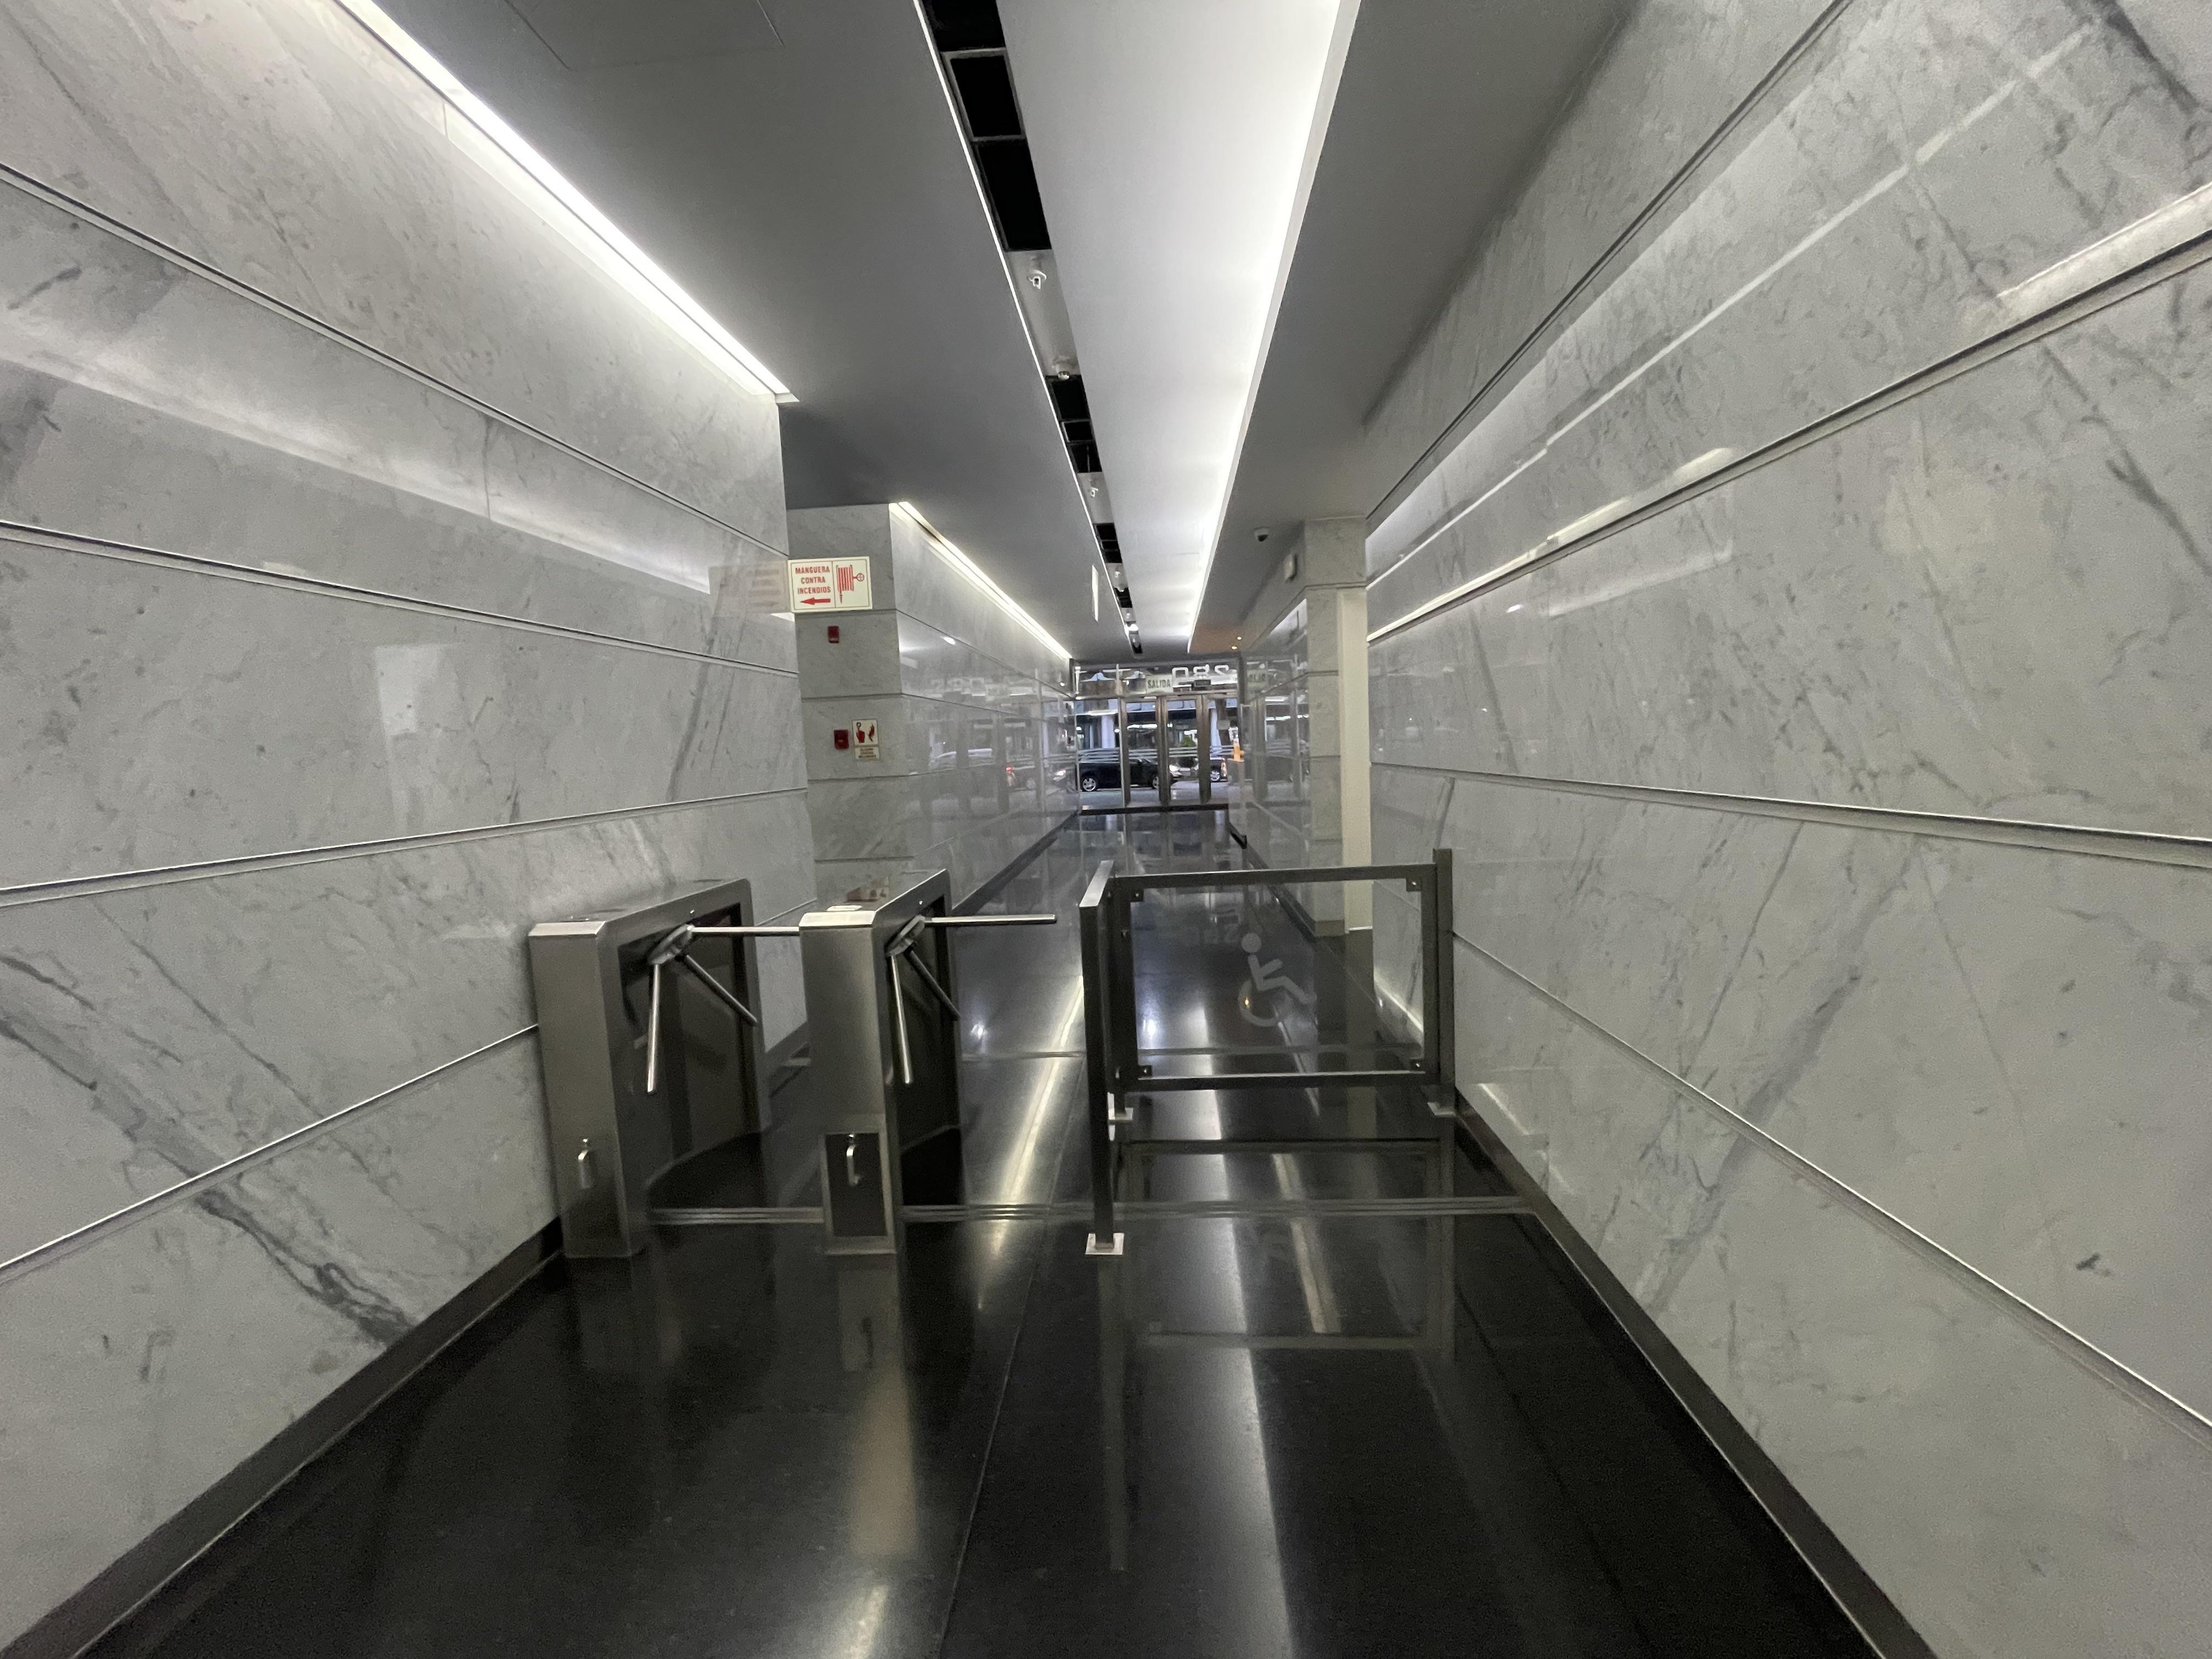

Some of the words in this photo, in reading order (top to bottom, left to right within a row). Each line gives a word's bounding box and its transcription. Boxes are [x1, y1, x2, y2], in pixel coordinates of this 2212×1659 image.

[795, 566, 830, 574] MANGUERA
[800, 576, 826, 584] CONTRA
[797, 586, 831, 594] INCENDIOS
[1148, 679, 1171, 689] SALIDA
